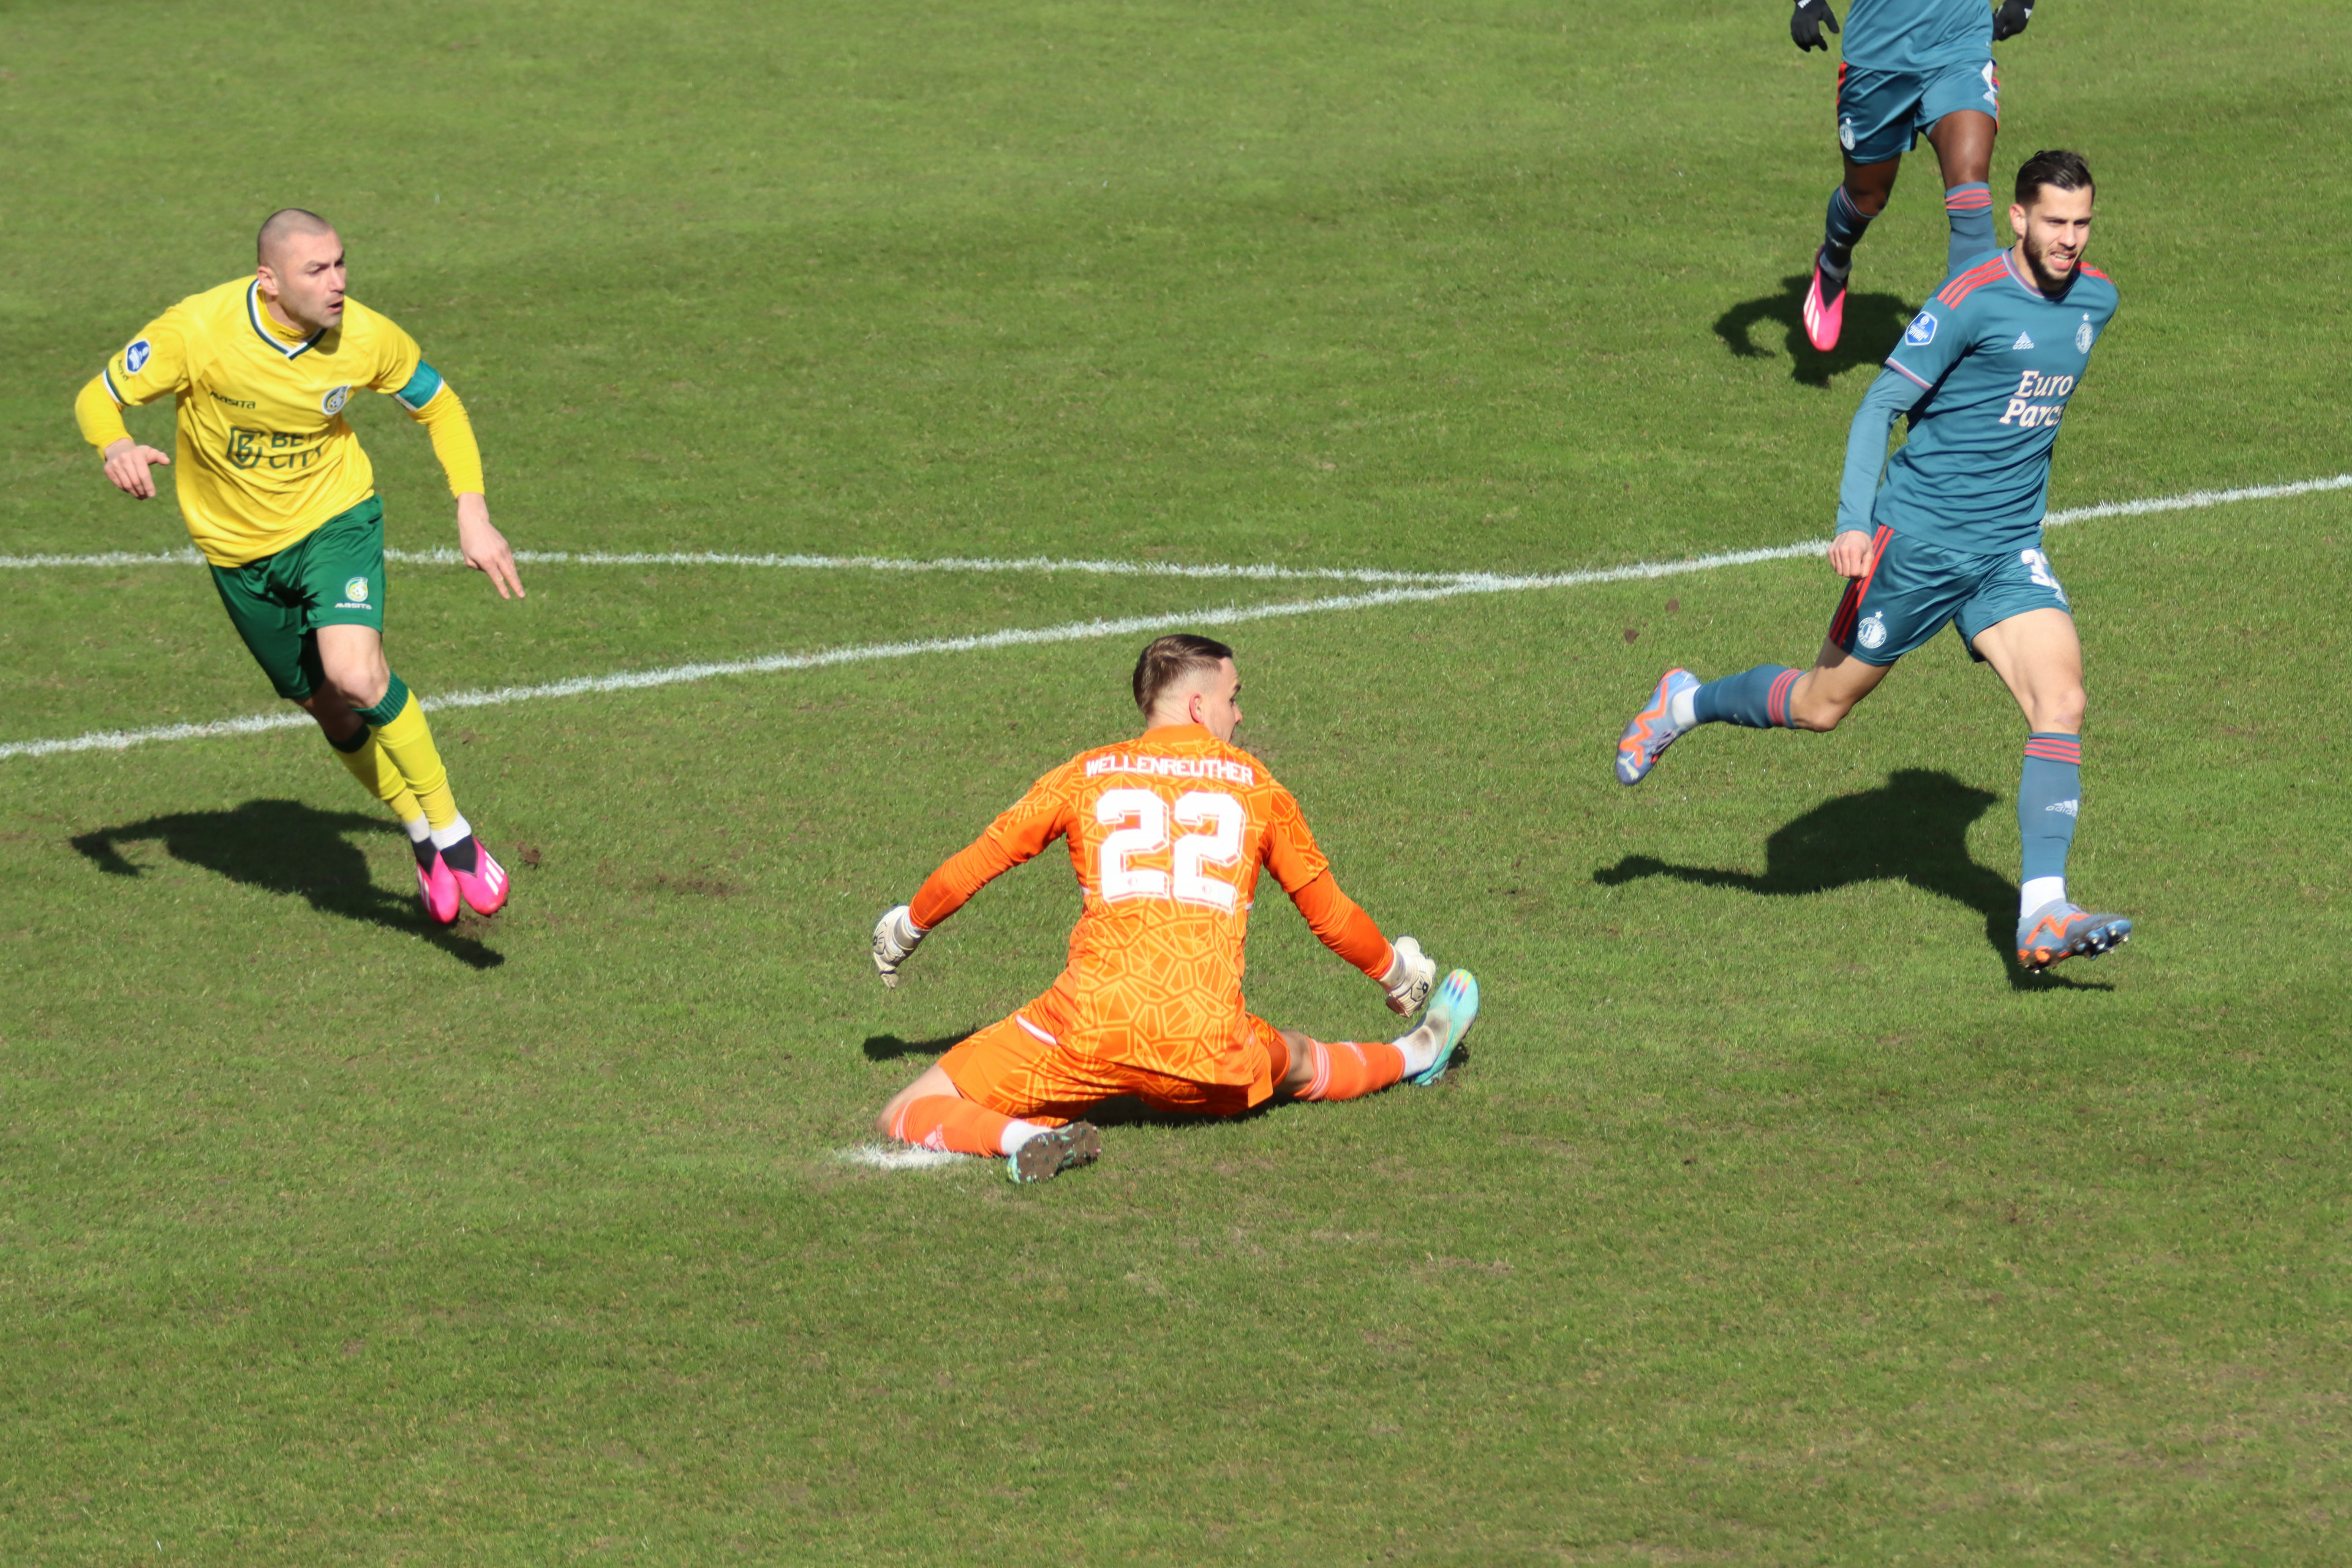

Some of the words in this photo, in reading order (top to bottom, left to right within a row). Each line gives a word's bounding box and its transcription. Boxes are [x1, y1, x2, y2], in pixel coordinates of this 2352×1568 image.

[2013, 369, 2074, 398] Euro
[2021, 548, 2062, 590] 3
[1086, 755, 1254, 786] WELLENREUTHER
[2045, 805, 2078, 818] adida
[1096, 788, 1246, 915] 22
